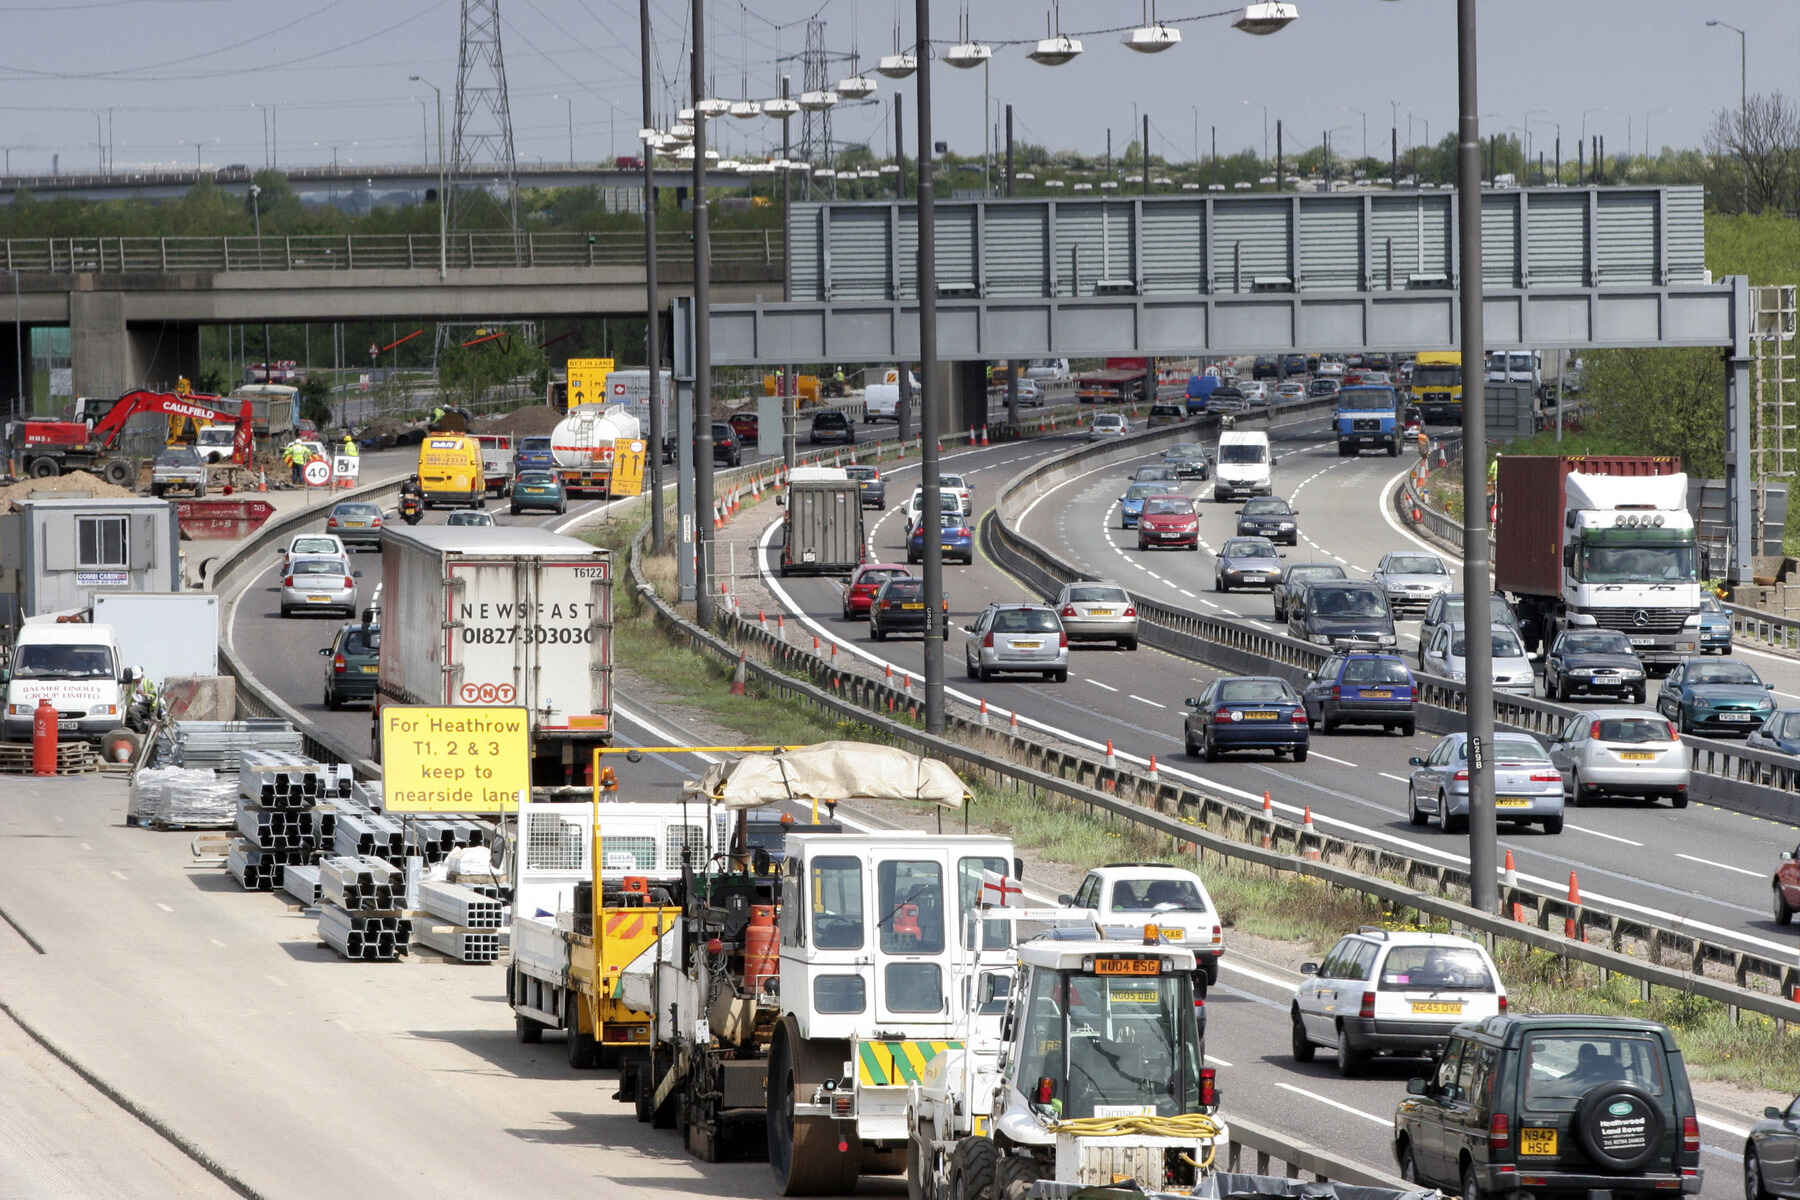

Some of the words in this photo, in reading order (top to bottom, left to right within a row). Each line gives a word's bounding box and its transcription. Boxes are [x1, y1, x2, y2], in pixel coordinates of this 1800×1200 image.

[162, 401, 215, 419] CAULFIELD
[307, 467, 328, 478] 40
[574, 567, 602, 578] T6122
[463, 627, 593, 645] 01827-303030
[463, 686, 513, 700] TNT
[390, 717, 419, 733] For
[430, 717, 520, 733] Heathrow
[447, 740, 458, 756] 2
[467, 741, 480, 756] &
[489, 741, 500, 756] 3
[421, 764, 466, 780] keep
[475, 765, 493, 779] to
[394, 787, 473, 802] nearside
[483, 787, 520, 802] lane
[1132, 959, 1155, 972] ESG
[1524, 1129, 1554, 1141] N942
[1601, 1127, 1621, 1136] Land
[1622, 1126, 1645, 1134] Rover
[1528, 1143, 1550, 1153] HSC
